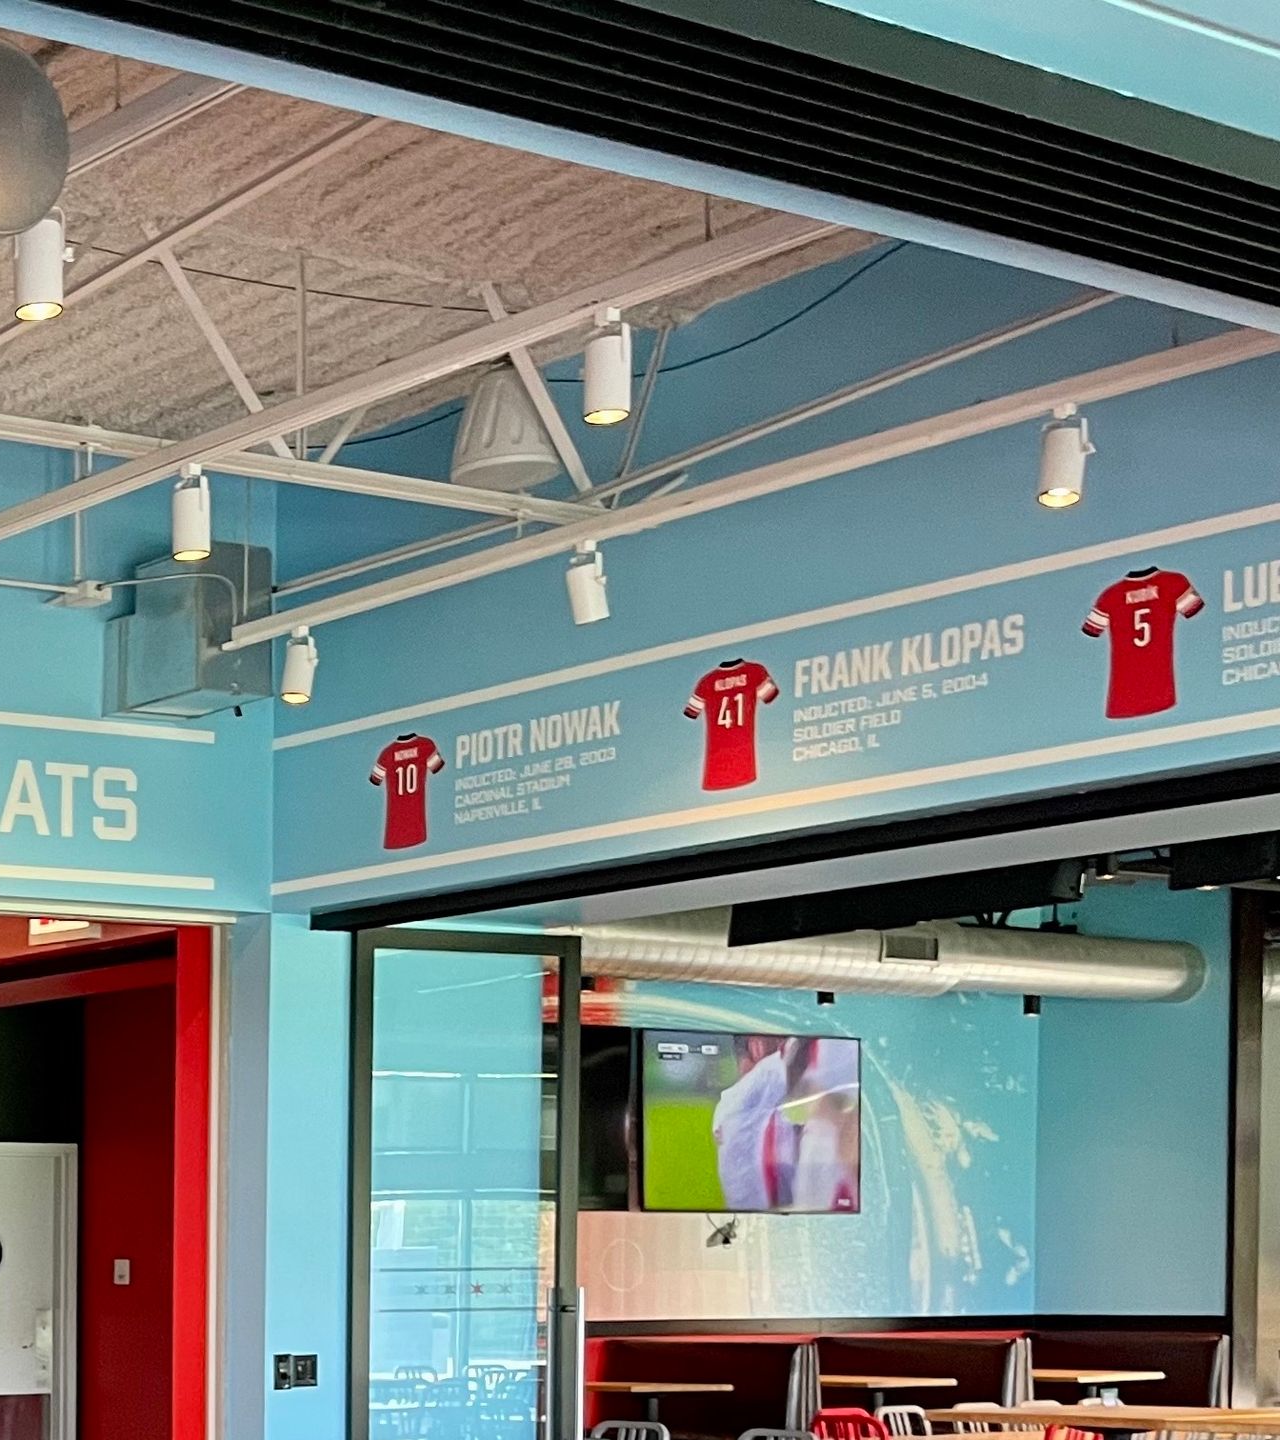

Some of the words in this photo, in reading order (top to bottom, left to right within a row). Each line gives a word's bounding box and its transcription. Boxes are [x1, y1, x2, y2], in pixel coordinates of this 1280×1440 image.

[1132, 608, 1152, 647] 5
[793, 640, 893, 698] FRANK
[900, 613, 1025, 676] KLOPAS
[717, 692, 744, 729] 41
[793, 696, 871, 722] INDUCTED:
[876, 685, 917, 708] JUNE
[921, 682, 938, 699] 5,
[942, 672, 989, 695] 2004
[455, 723, 524, 769] PIOTR
[529, 700, 621, 754] NOWAK
[792, 718, 856, 742] SOLDIER
[859, 709, 902, 731] FIELD
[395, 763, 418, 796] 10
[454, 786, 514, 809] CARDINAL
[516, 773, 571, 796] STADIUM
[455, 767, 517, 791] INDUCTED:
[520, 760, 553, 779] JUNE
